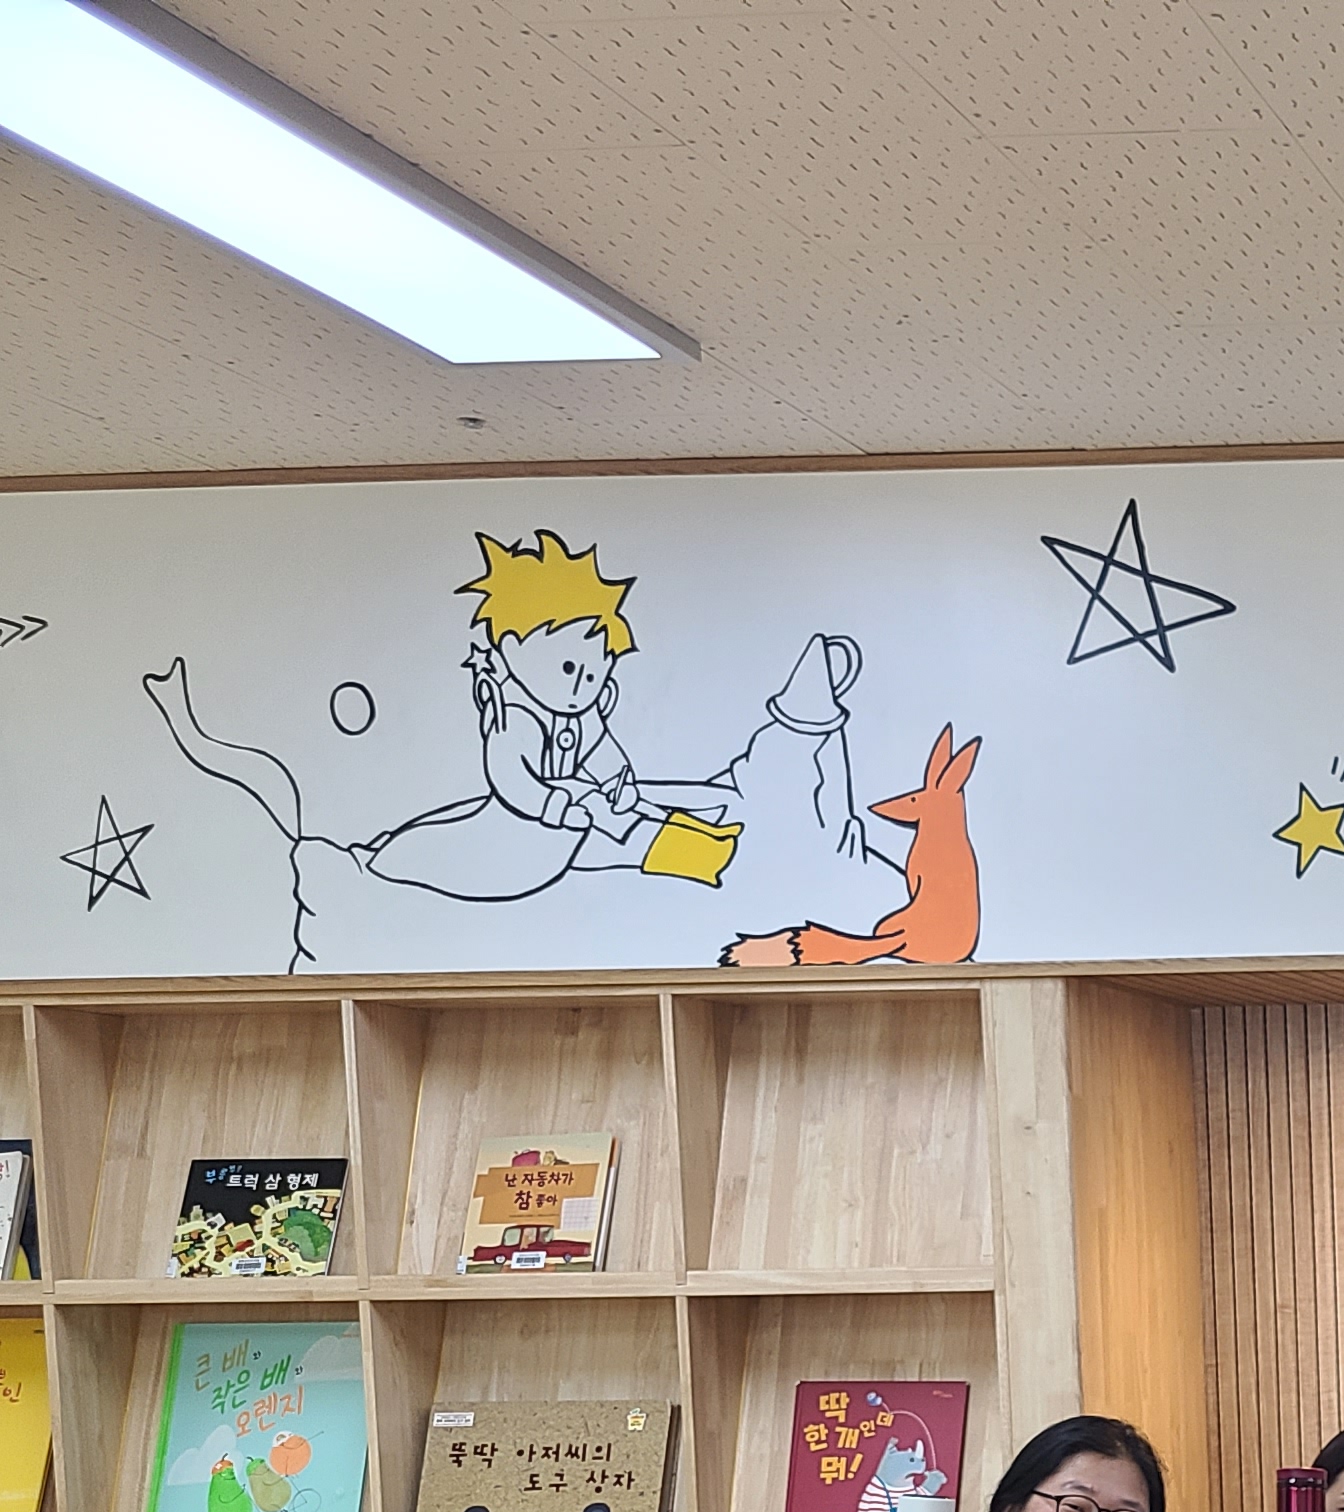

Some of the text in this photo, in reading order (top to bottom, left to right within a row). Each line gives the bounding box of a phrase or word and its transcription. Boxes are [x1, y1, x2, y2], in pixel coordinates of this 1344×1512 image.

[226, 1172, 319, 1190] 트럭 삼 형제
[504, 1171, 575, 1187] 난 자동차가
[514, 1189, 532, 1211] 참
[195, 1352, 211, 1392] 큰
[211, 1368, 251, 1415] 작은
[236, 1384, 305, 1438] 오렌지
[818, 1391, 850, 1423] 딱
[803, 1423, 829, 1452] 한
[516, 1443, 613, 1463] 아저씨의
[523, 1469, 636, 1494] 도구 상자
[818, 1453, 864, 1485] 뭐!
